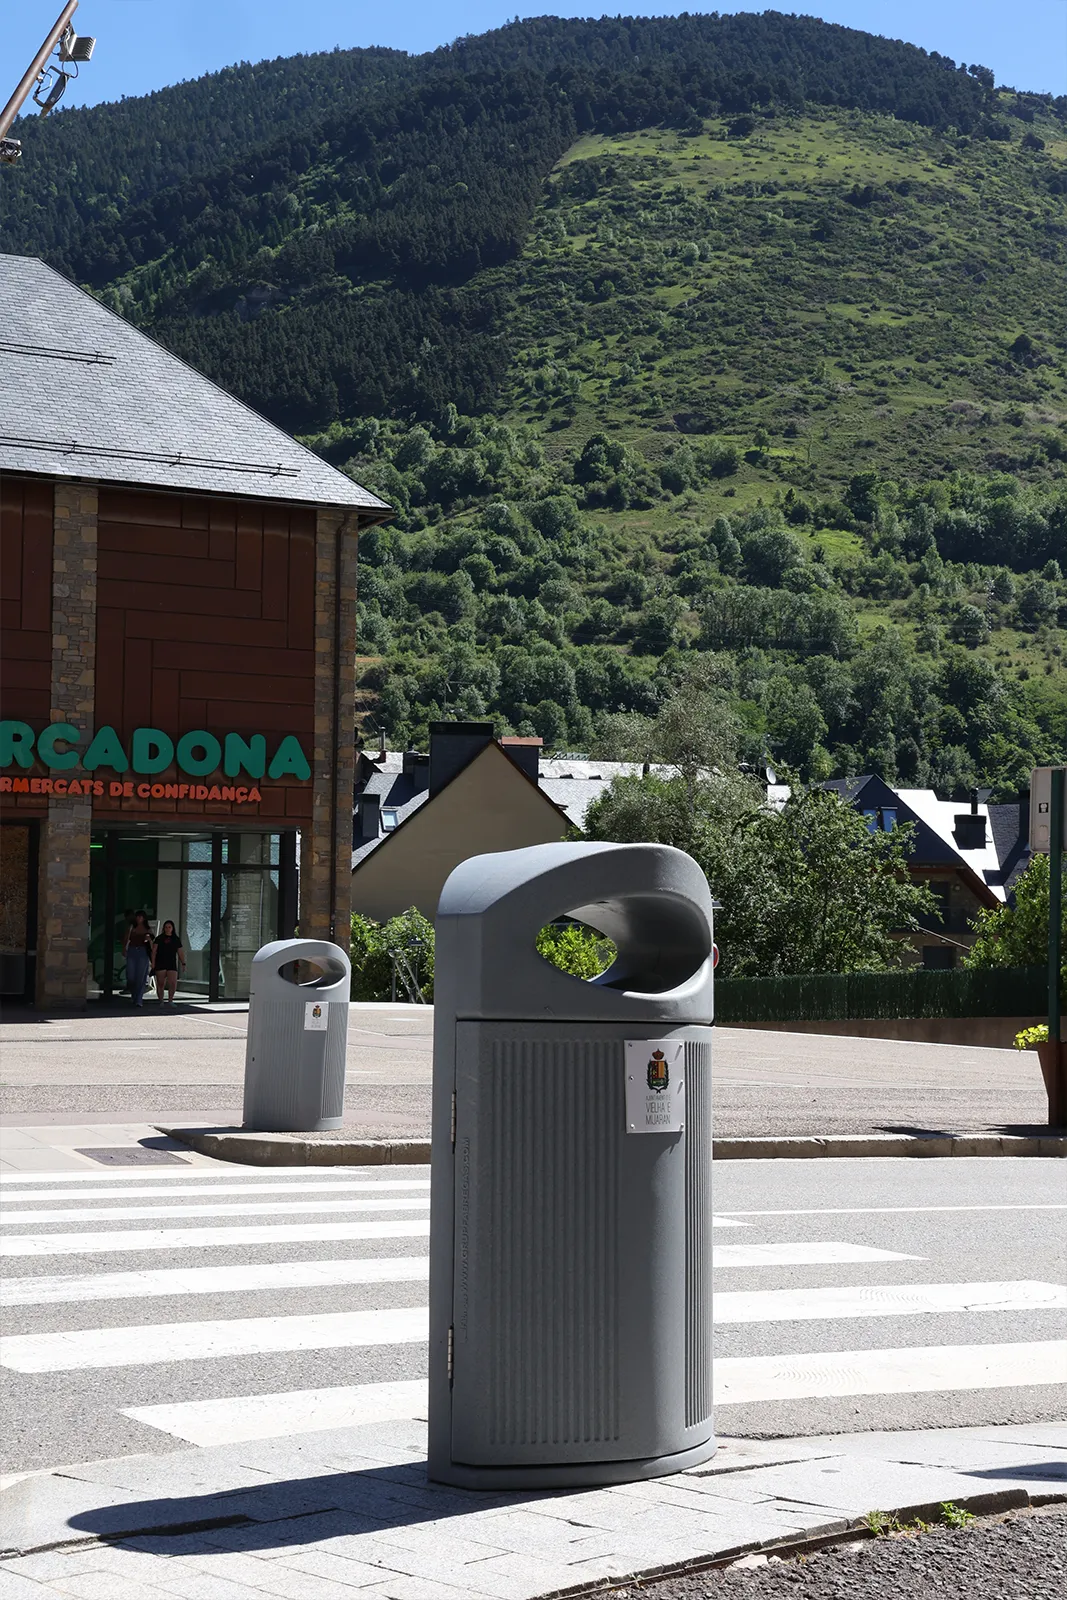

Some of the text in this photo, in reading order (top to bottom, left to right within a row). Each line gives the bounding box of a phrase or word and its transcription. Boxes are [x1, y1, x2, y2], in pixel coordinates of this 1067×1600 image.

[0, 720, 311, 780] RCADONA
[109, 782, 134, 797] DE
[137, 783, 262, 803] CONFIDANÇA
